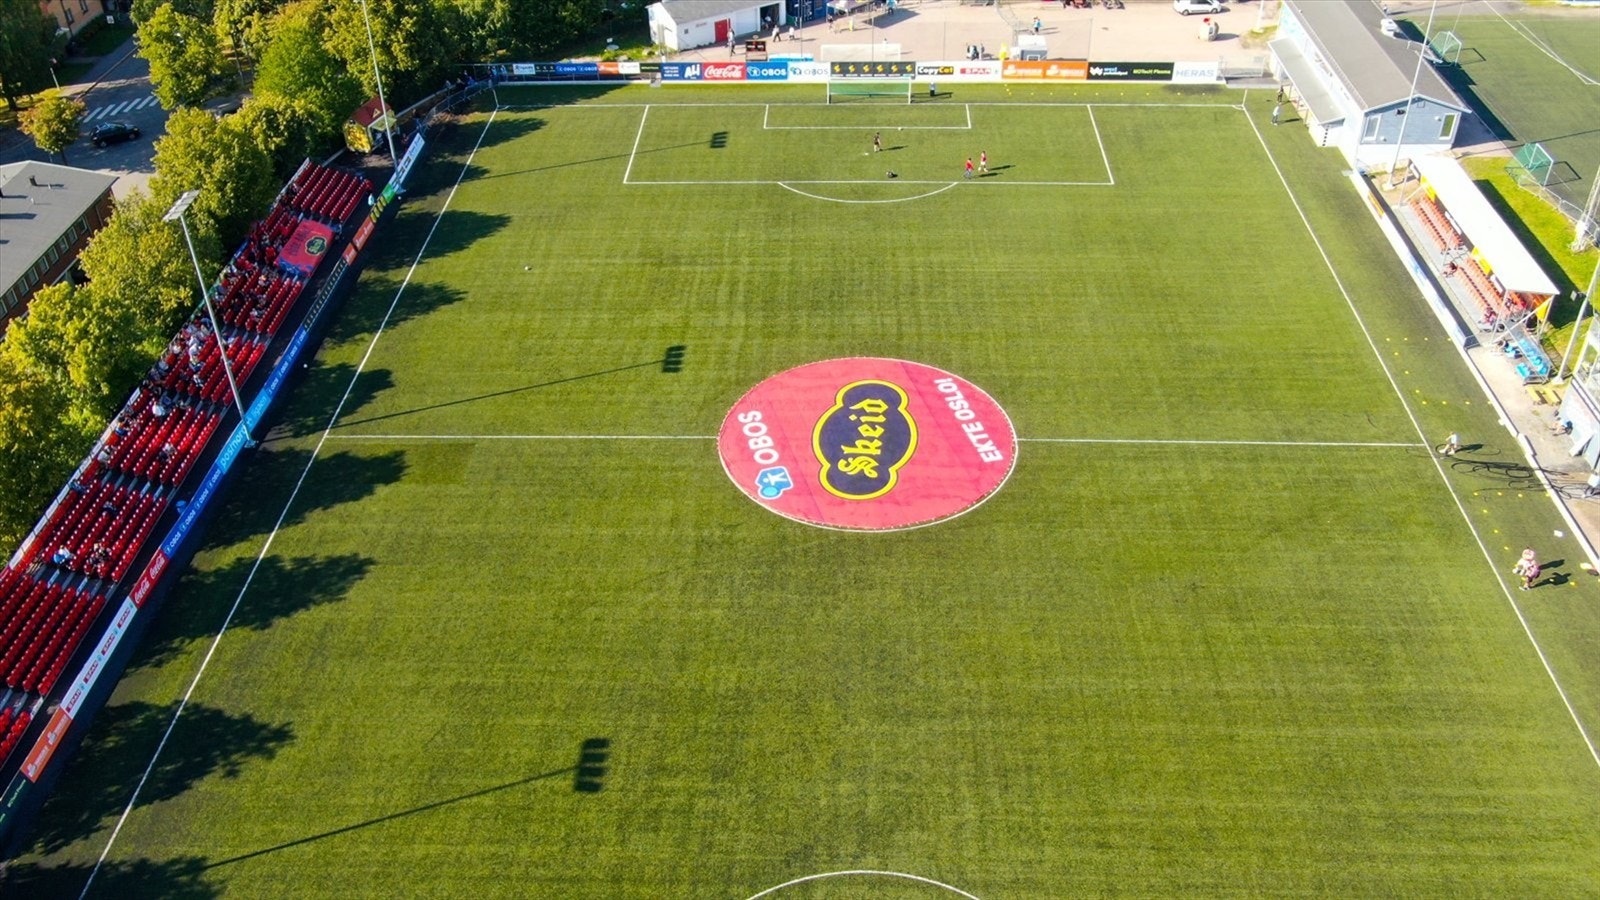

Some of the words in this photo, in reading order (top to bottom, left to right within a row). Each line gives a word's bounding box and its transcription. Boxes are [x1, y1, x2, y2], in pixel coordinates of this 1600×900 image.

[918, 66, 953, 75] CopyCat
[738, 410, 780, 464] OBOS
[838, 398, 888, 478] Skeid
[962, 422, 1003, 463] EKTE
